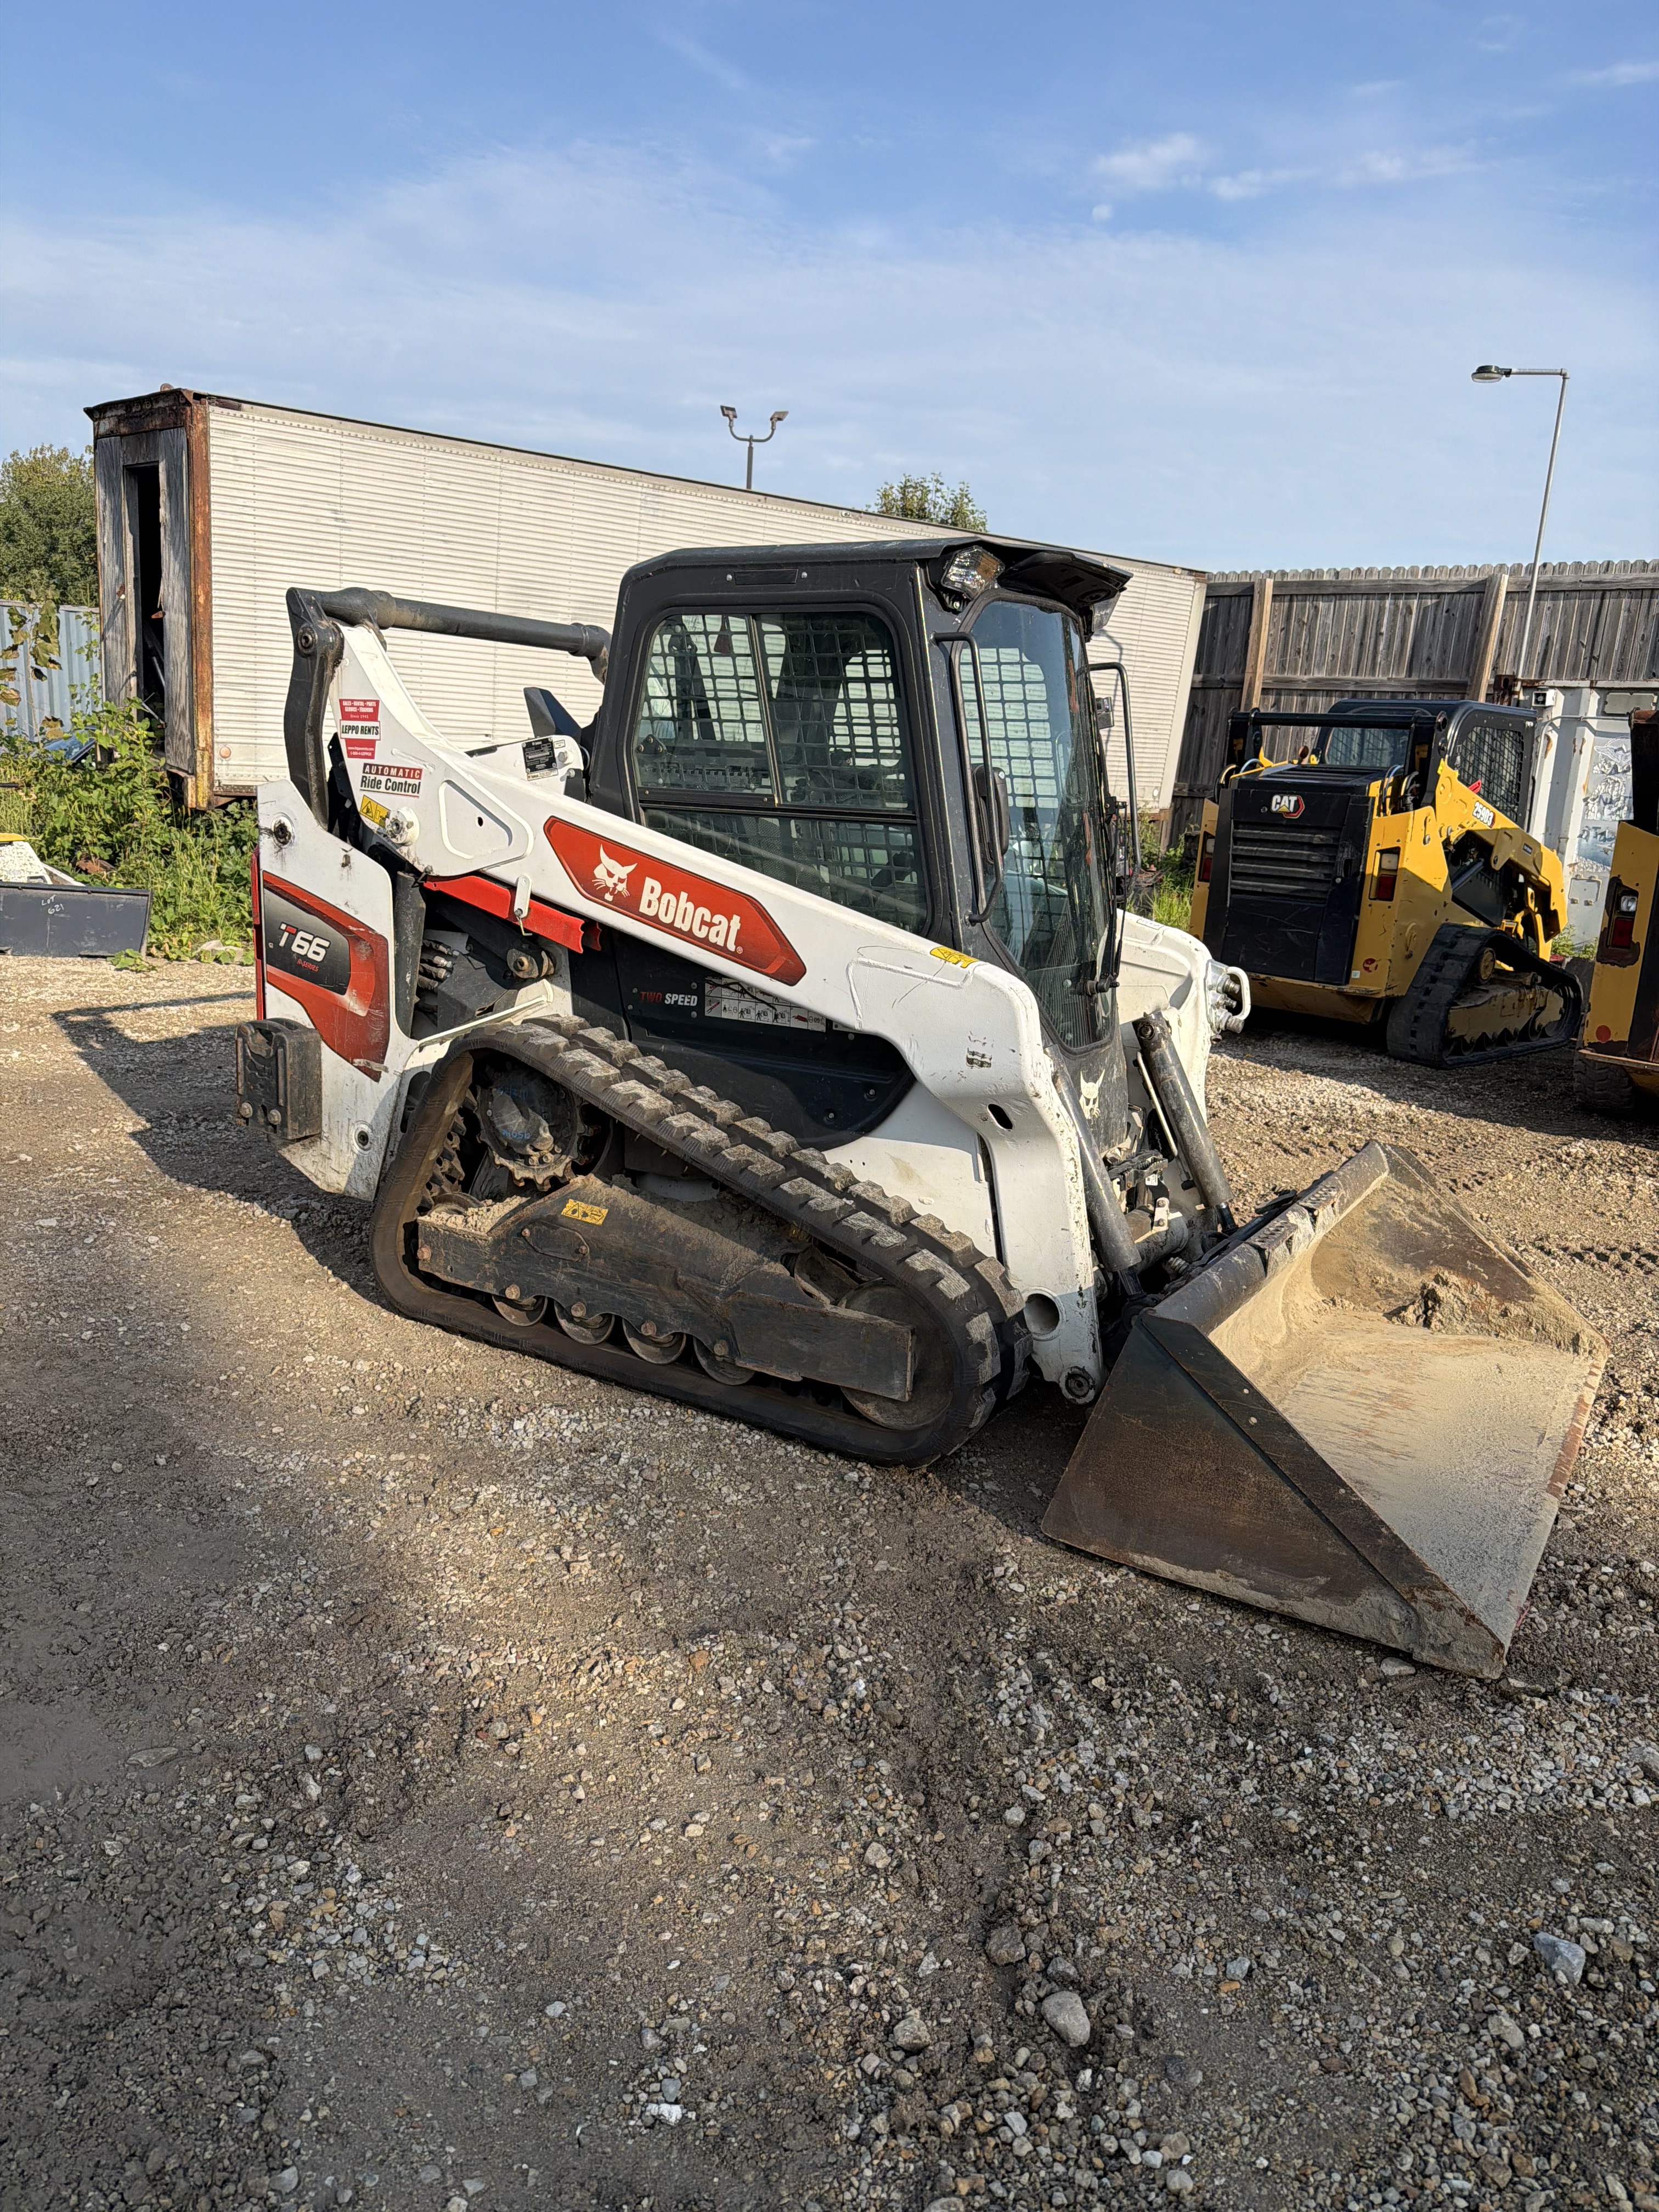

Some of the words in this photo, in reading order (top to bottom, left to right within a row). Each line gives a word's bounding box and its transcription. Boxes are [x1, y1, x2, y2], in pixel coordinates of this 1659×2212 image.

[342, 725, 359, 735] LEPPO
[360, 725, 379, 736] RENTS
[364, 765, 420, 778] AUTOMATIC
[360, 775, 382, 790] Ride
[385, 778, 421, 794] Control
[1271, 795, 1297, 812] CAT
[41, 894, 57, 906] LOT
[48, 903, 65, 915] 621
[639, 876, 741, 952] Bobcat
[279, 923, 330, 962] T66
[640, 991, 662, 1003] TWO
[664, 993, 698, 1007] SPEED
